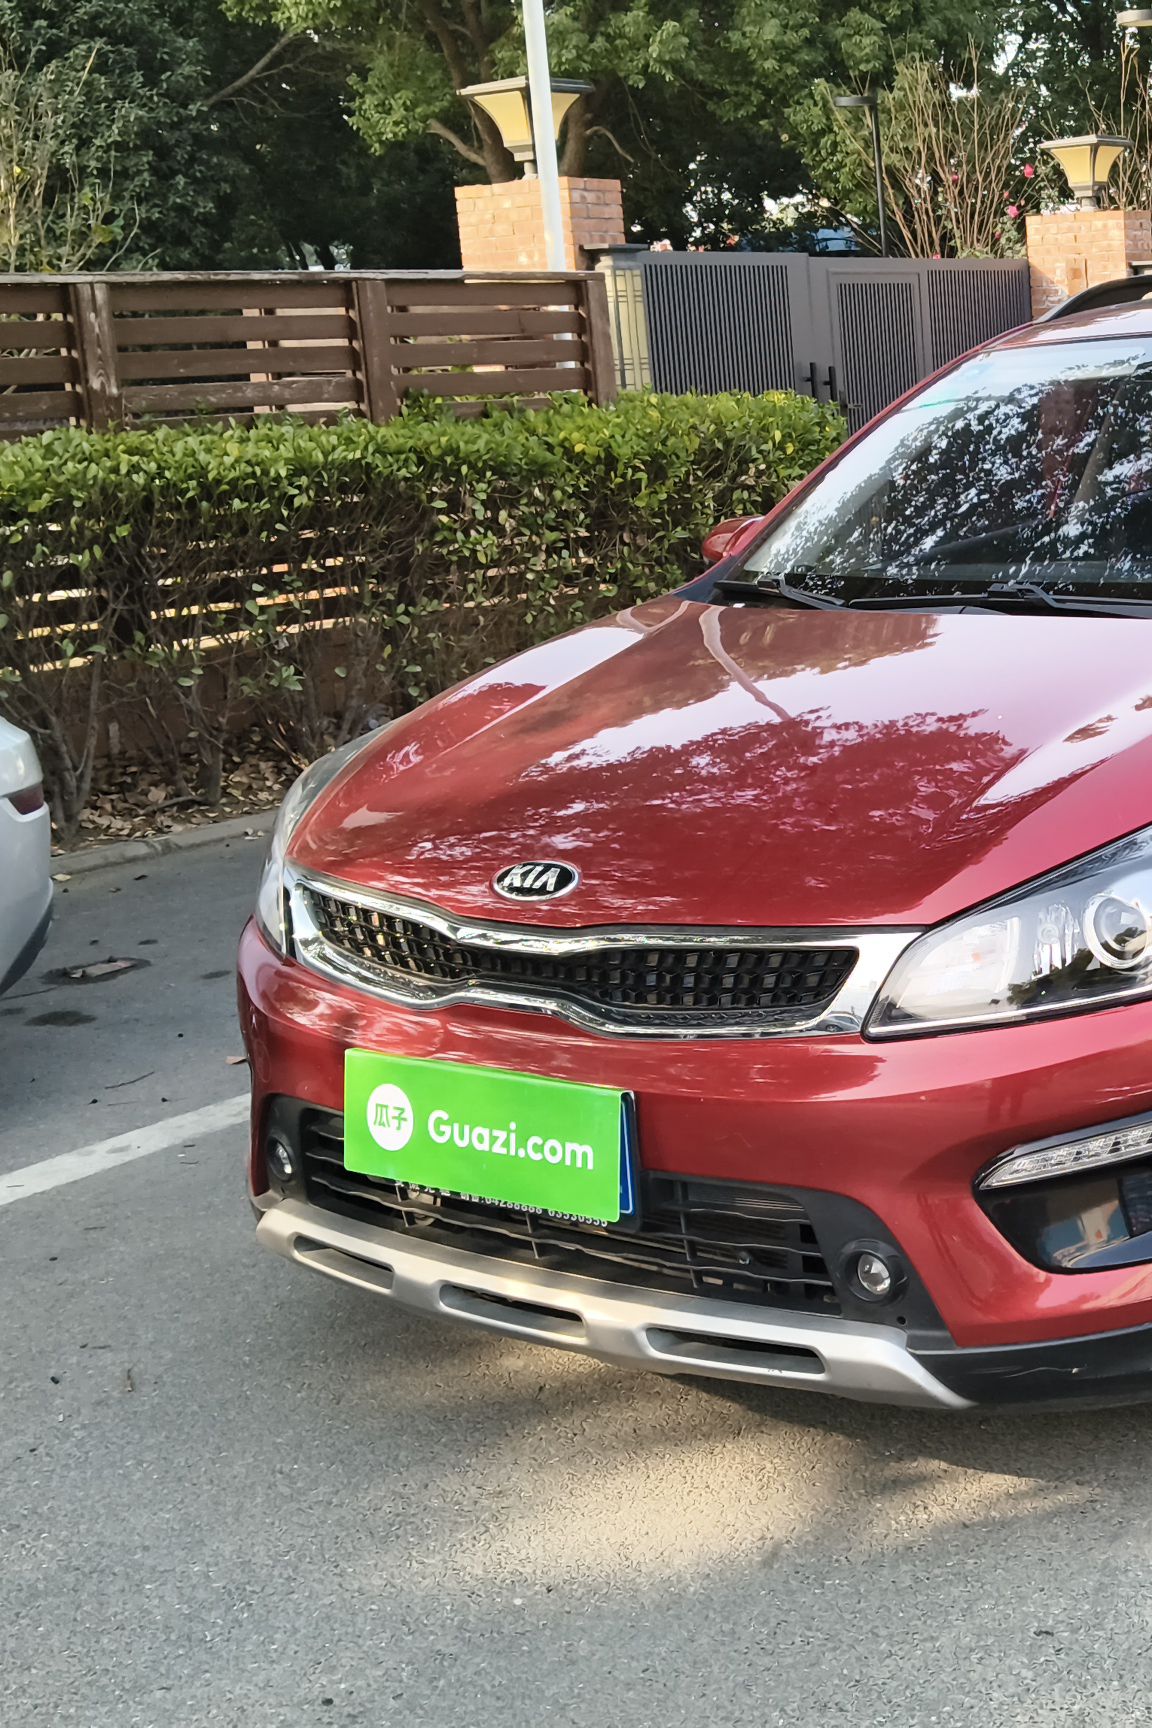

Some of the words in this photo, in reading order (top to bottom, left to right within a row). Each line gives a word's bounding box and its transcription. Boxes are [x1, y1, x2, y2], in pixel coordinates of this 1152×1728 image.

[502, 864, 561, 891] KIA
[373, 1103, 408, 1131] 瓜子
[427, 1109, 594, 1170] Guazi.com
